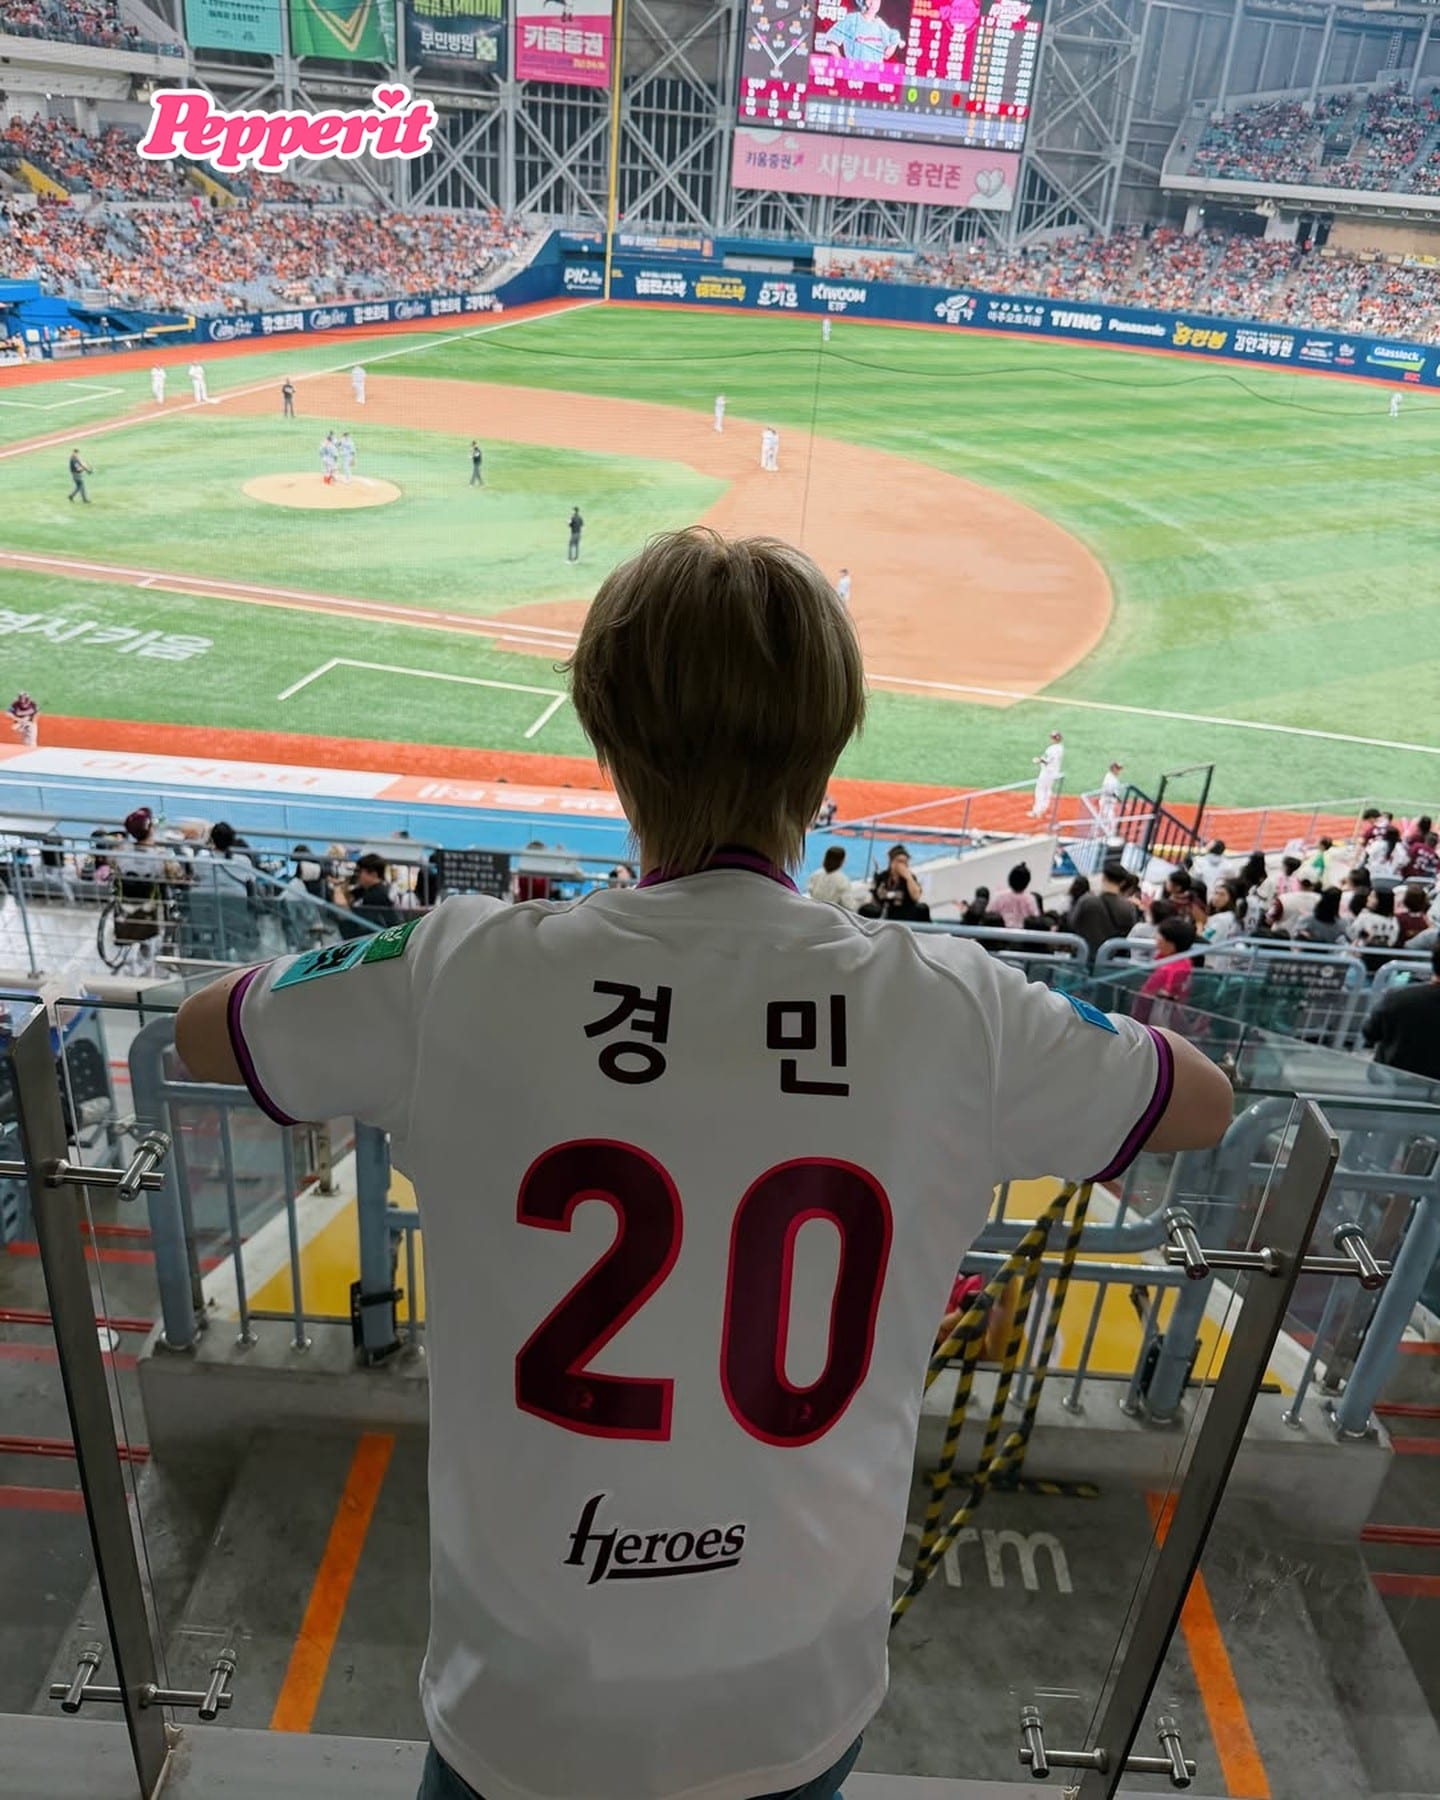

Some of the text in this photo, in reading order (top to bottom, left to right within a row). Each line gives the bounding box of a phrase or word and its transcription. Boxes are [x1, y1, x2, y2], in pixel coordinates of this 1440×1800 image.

[420, 30, 475, 53] 부민병원
[523, 25, 604, 58] 키움증권
[745, 151, 792, 171] 키움증권
[906, 161, 963, 190] 홈런존
[757, 289, 798, 308] 요기요
[812, 283, 867, 303] KIWOOM
[828, 301, 847, 312] ETF
[989, 301, 1045, 314] VOLVO
[1050, 309, 1103, 331] TVING
[1108, 318, 1167, 337] Panasonic
[1233, 334, 1295, 359] 김안과병원
[1374, 346, 1420, 362] Glasslock
[514, 1137, 894, 1449] 20
